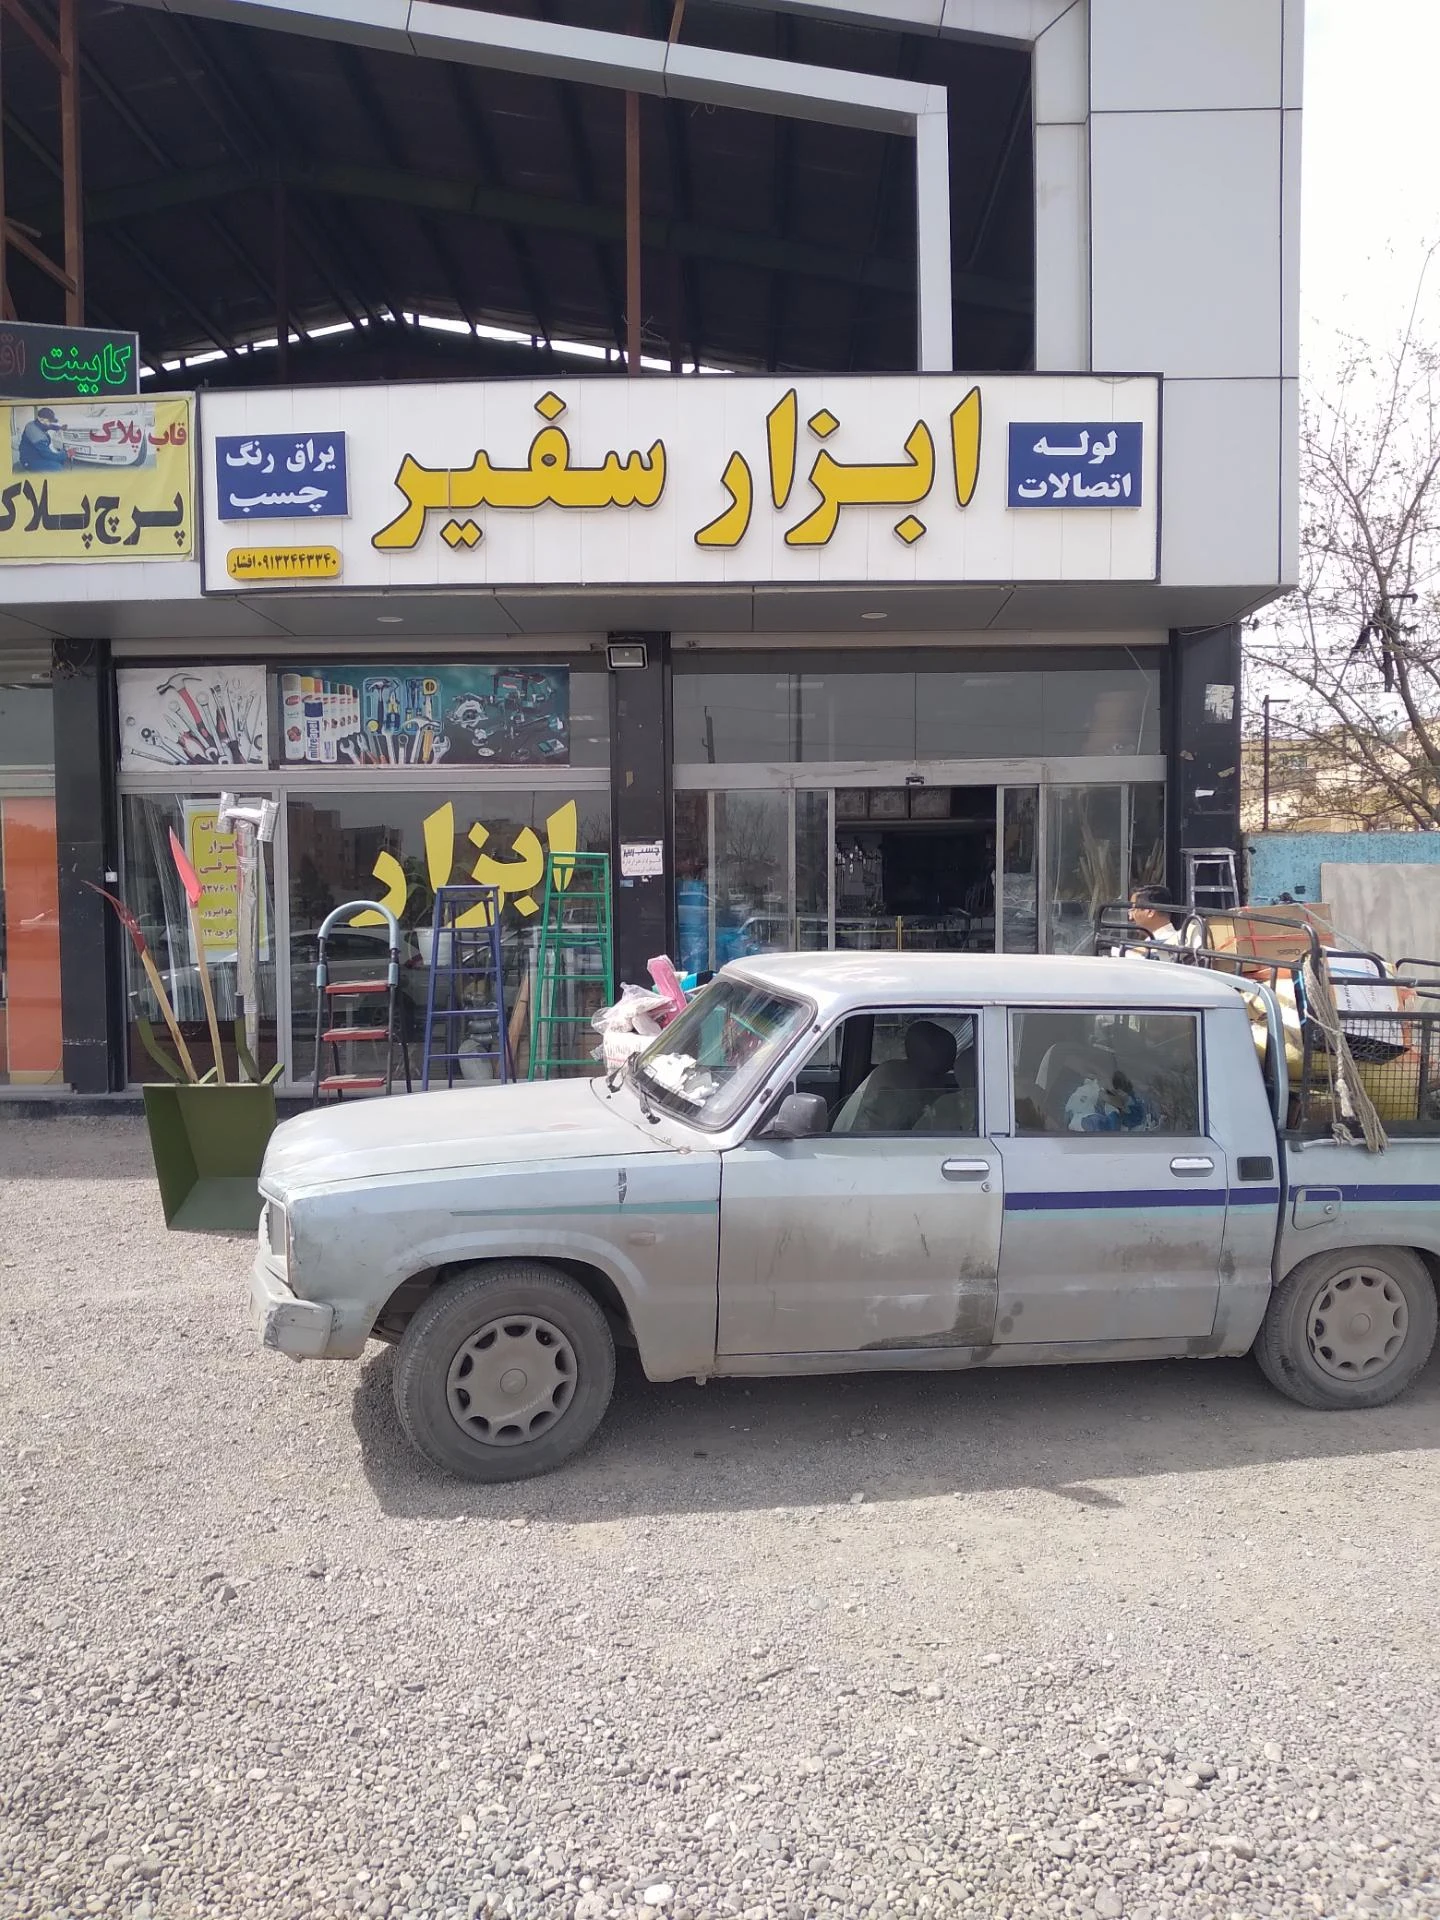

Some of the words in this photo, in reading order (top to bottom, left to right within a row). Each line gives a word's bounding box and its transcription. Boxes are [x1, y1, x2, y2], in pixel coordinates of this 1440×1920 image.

[40, 342, 132, 394] کابینت
[89, 420, 143, 453] پلاک
[148, 422, 188, 451] قاب
[1032, 430, 1119, 464] لوله
[225, 440, 275, 473] رنگ
[286, 438, 337, 472] یراق
[371, 390, 667, 549] سفیر
[694, 384, 983, 547] ابزار
[229, 486, 329, 513] چسب
[1017, 472, 1132, 498] اتصالات
[94, 491, 186, 547] پرچ
[231, 553, 257, 573] افشار
[257, 552, 337, 570] ۰۹۱۳۲۴۴۳۳۴۰
[208, 839, 236, 854] بزار
[348, 799, 577, 929] ابزار
